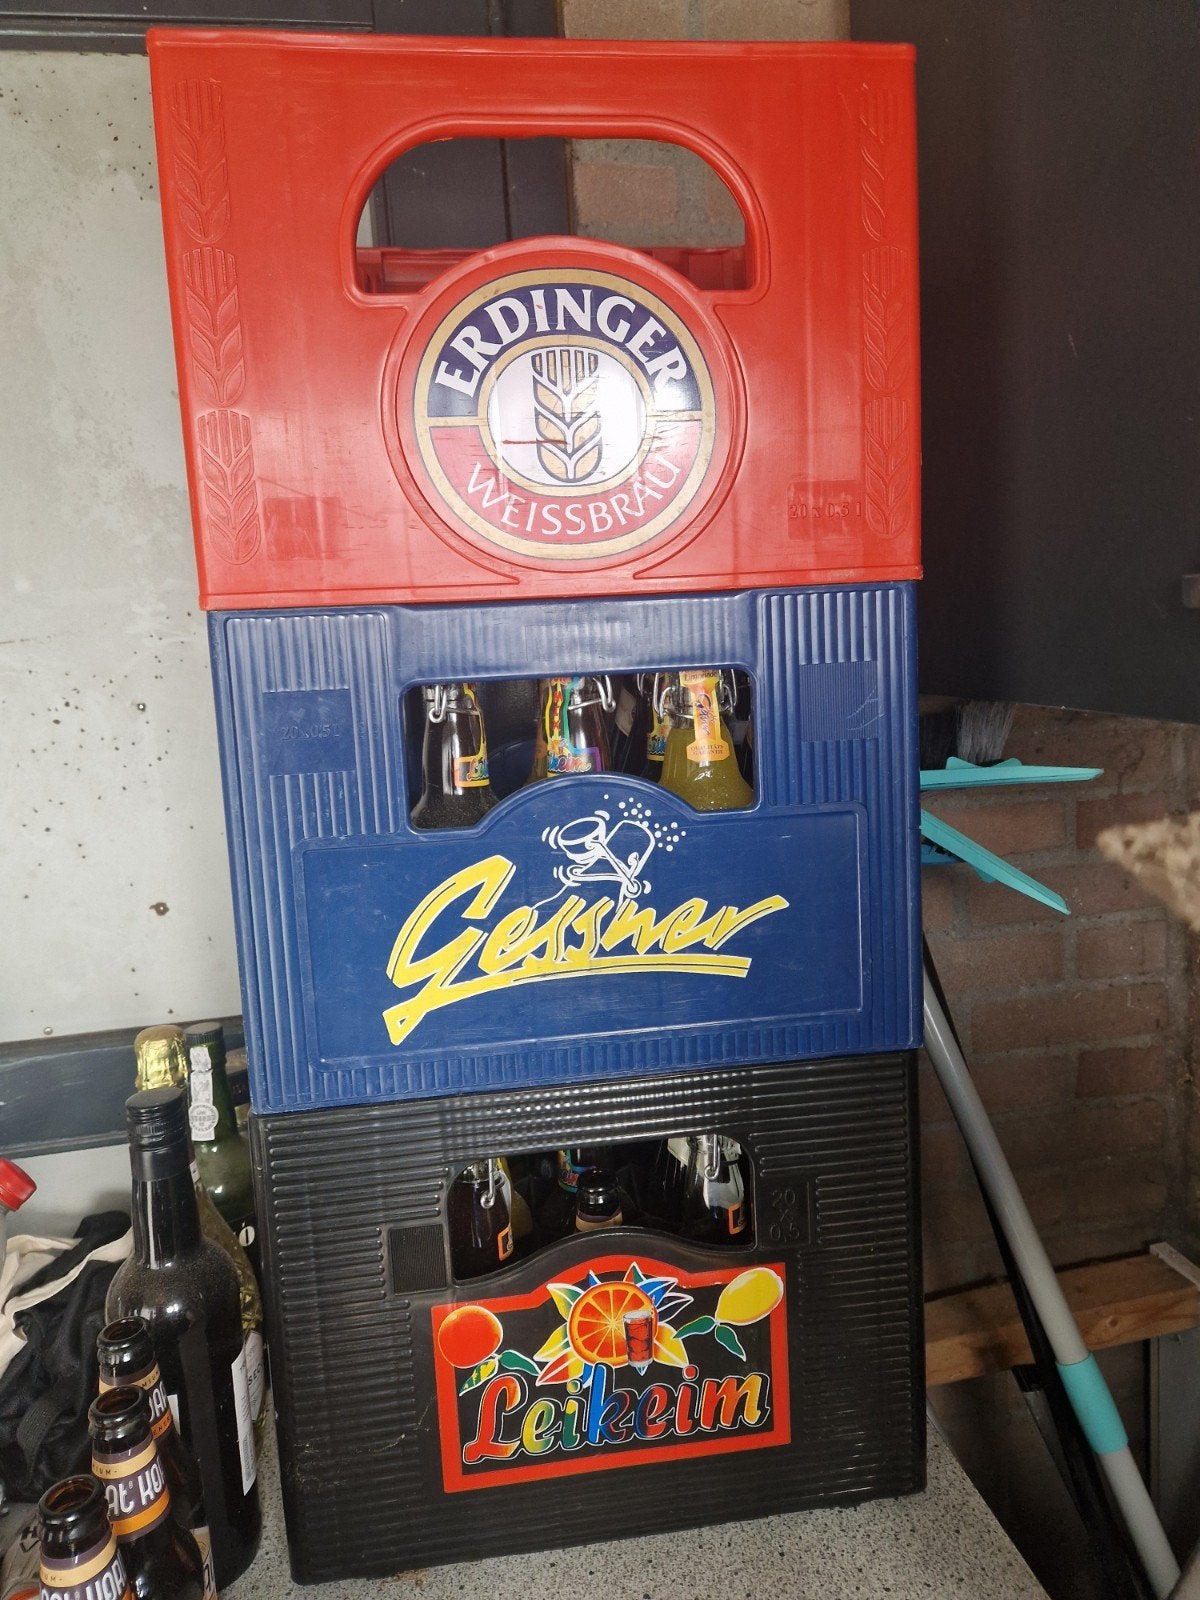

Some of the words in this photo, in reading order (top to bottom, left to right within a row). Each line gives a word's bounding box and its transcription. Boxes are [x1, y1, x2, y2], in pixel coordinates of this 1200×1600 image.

[435, 288, 688, 398] ERDINGER
[466, 455, 682, 536] WEISSBRÄU
[383, 855, 790, 1046] Gessner
[463, 1361, 771, 1465] Leikeim
